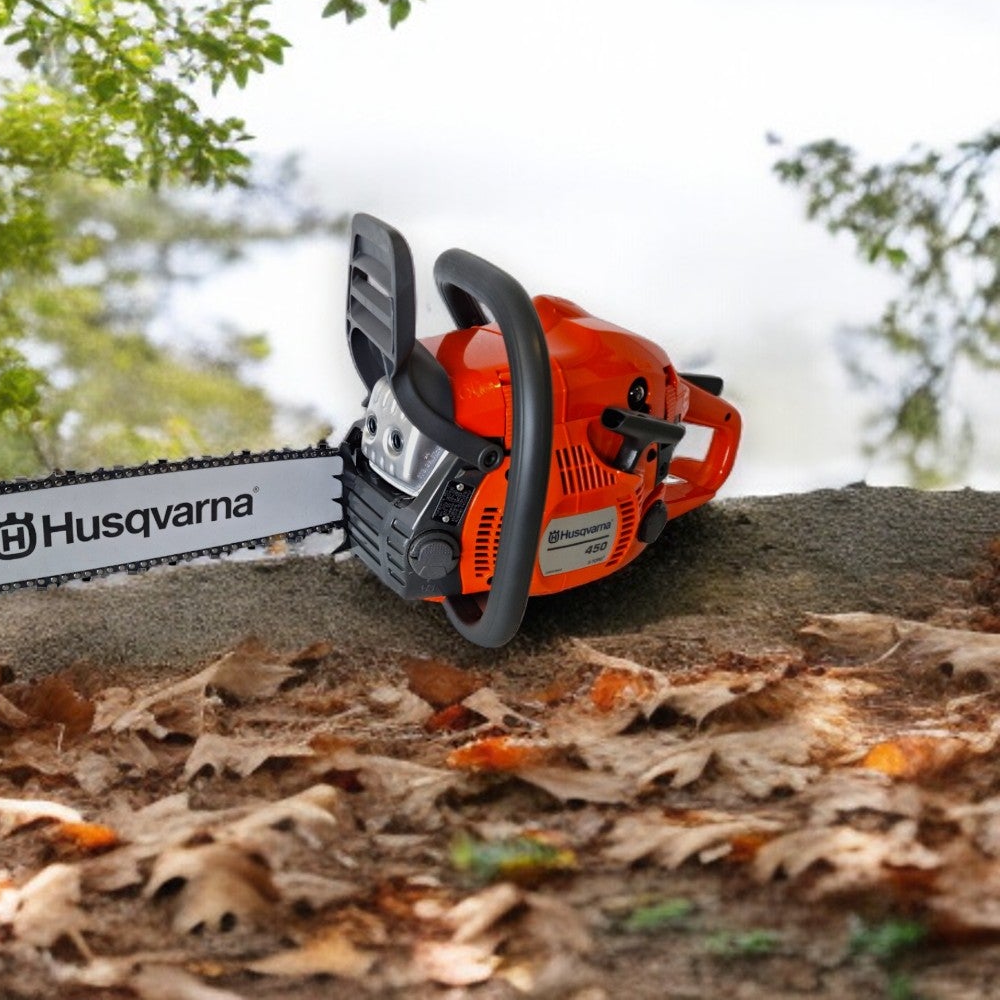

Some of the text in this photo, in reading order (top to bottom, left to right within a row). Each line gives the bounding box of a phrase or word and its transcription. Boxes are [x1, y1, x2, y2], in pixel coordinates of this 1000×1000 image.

[42, 493, 254, 548] Husqvarna
[560, 521, 612, 541] Husqvarna
[584, 541, 608, 555] 450
